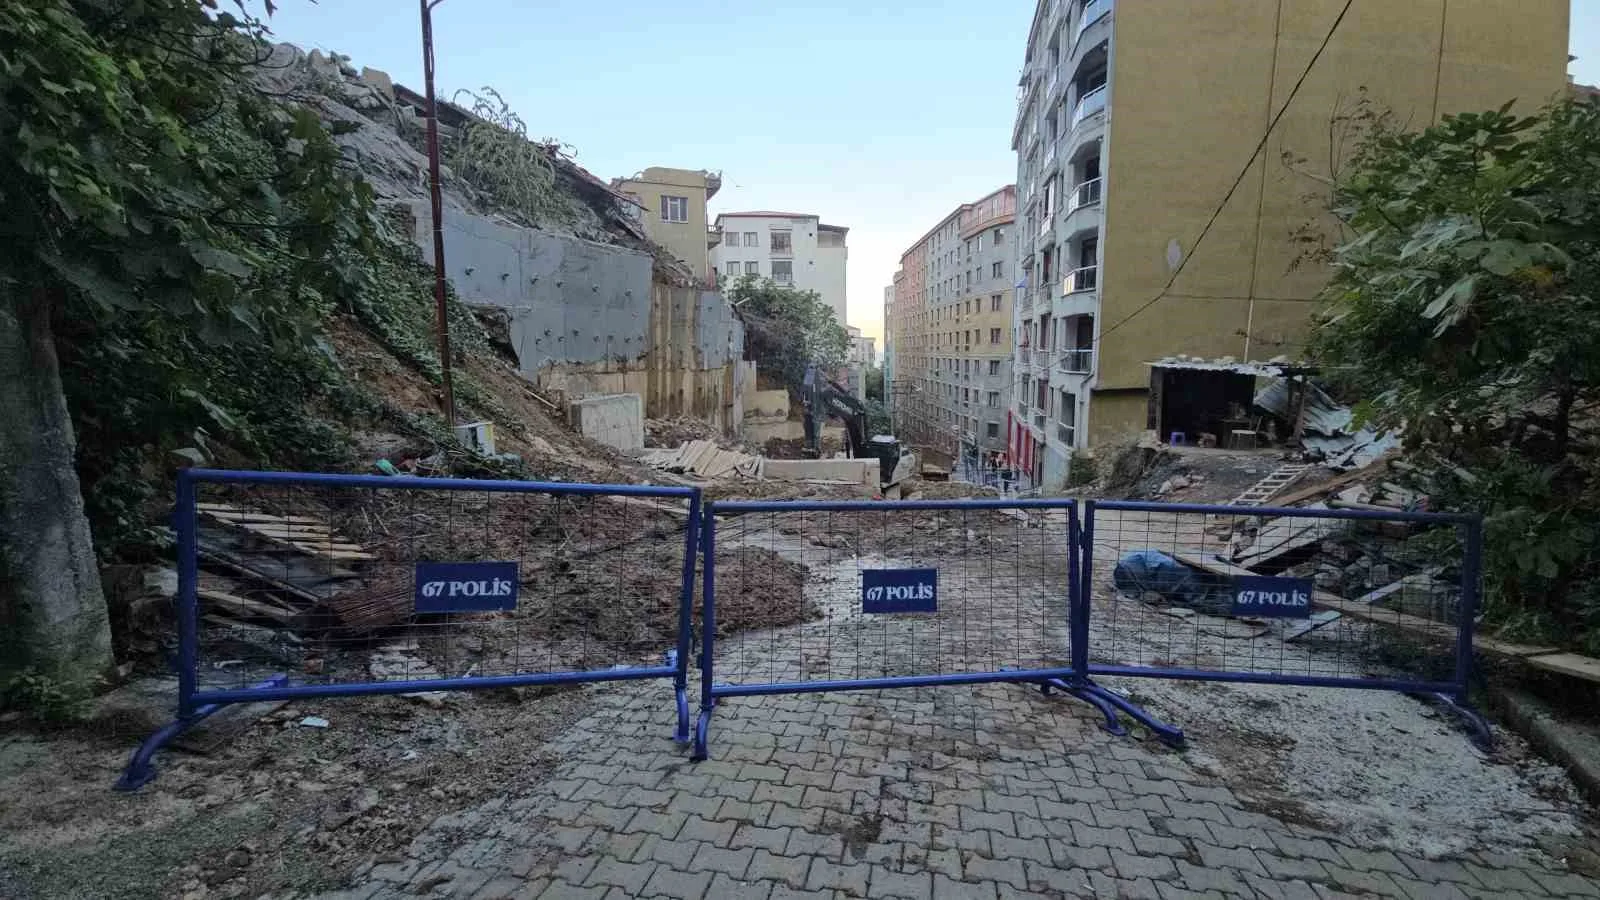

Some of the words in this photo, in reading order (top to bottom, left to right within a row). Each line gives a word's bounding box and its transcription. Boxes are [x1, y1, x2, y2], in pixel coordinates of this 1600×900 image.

[422, 581, 445, 597] 67
[447, 577, 512, 597] POLİS
[866, 586, 883, 601] 67
[886, 582, 933, 600] POLİS
[1237, 590, 1255, 604] 67
[1258, 589, 1308, 606] POLİS
